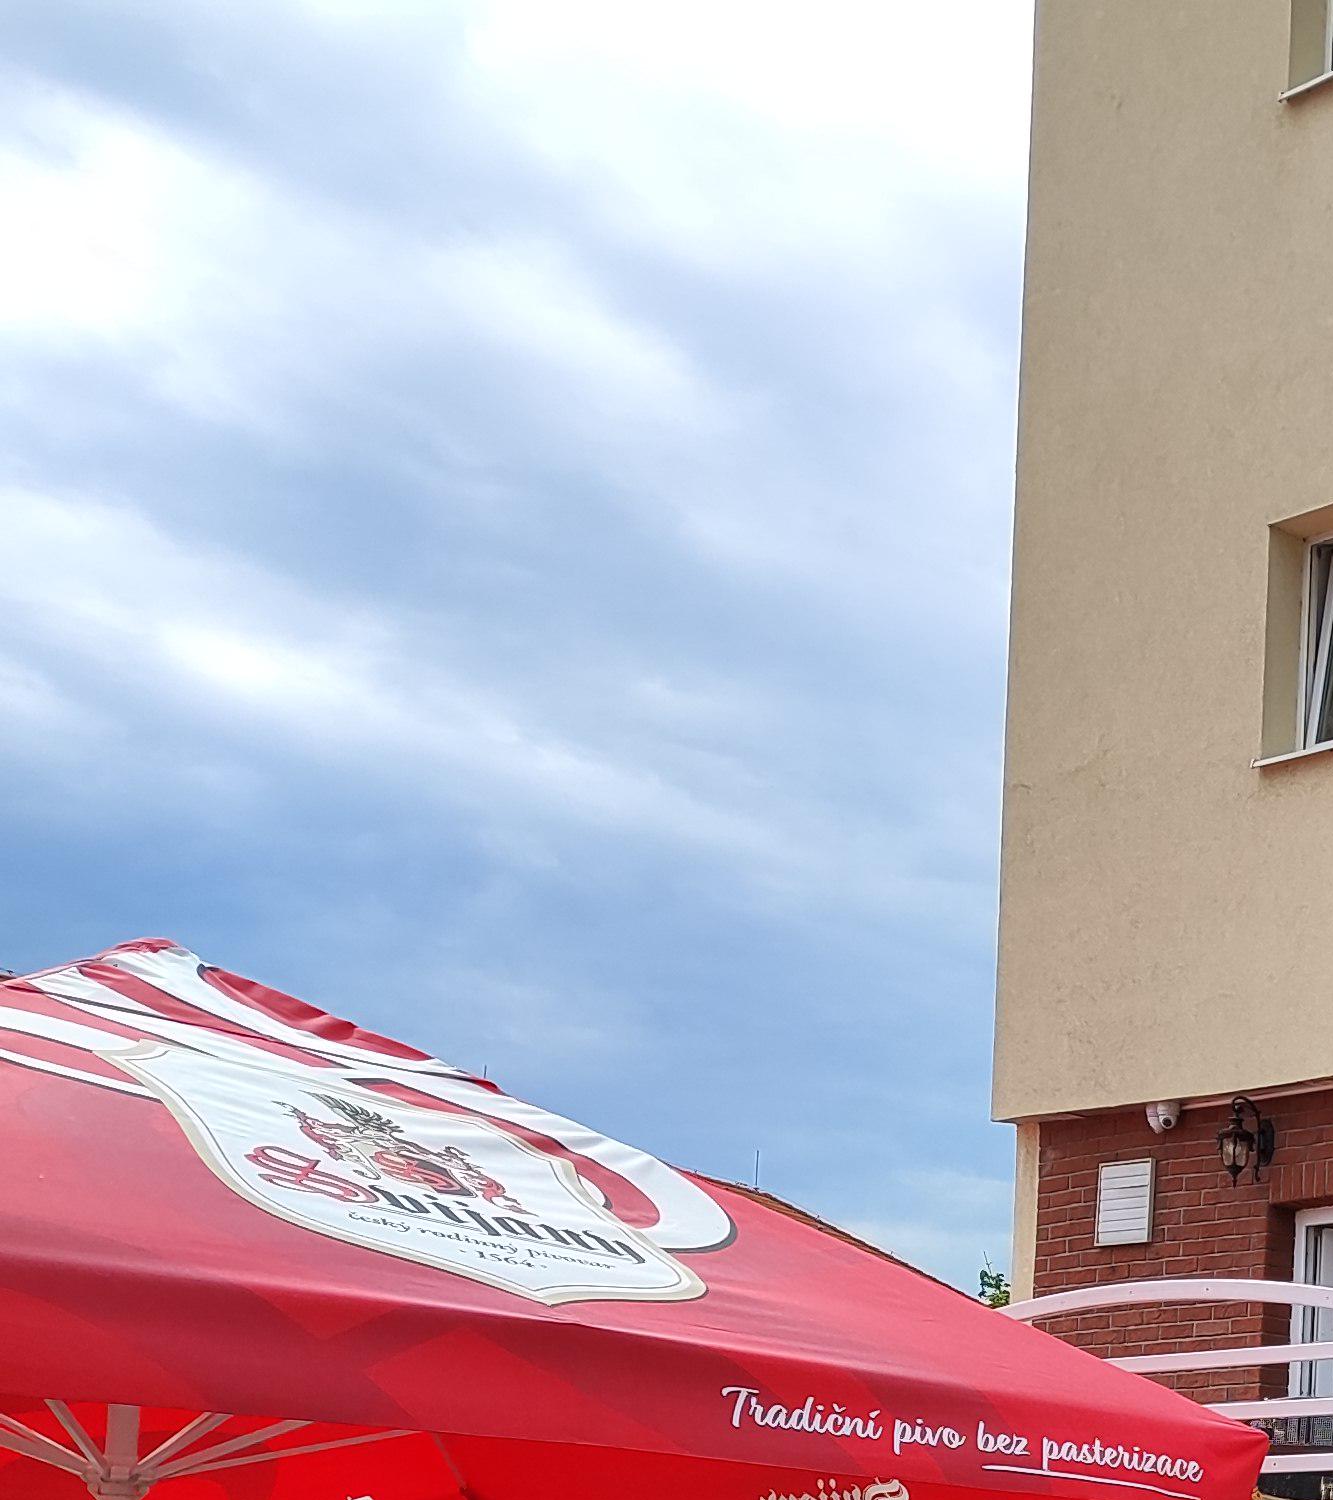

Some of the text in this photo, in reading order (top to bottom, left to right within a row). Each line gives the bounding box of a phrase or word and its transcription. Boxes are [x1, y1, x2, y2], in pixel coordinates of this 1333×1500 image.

[244, 1145, 646, 1264] Svijany
[721, 1386, 1204, 1483] Tradiční pivo bez pasterizace
